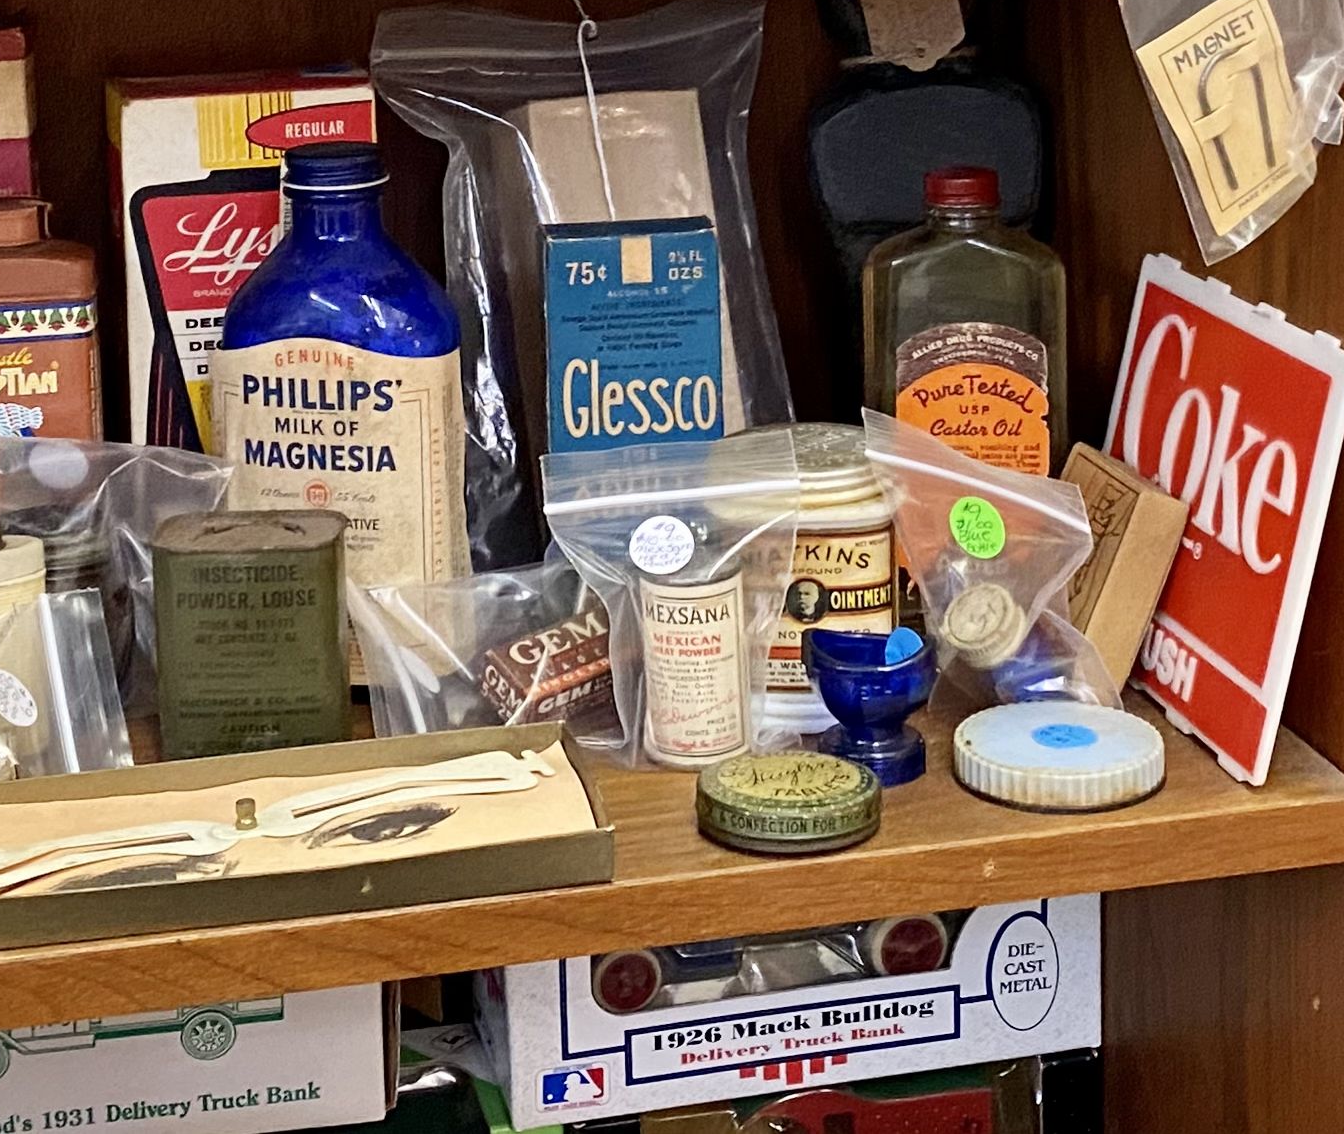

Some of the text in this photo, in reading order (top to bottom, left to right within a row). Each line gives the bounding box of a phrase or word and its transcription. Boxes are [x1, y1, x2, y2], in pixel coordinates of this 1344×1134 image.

[1172, 8, 1259, 76] MAGNET
[284, 119, 345, 139] REGULAR
[565, 261, 608, 286] 75¢
[192, 288, 233, 298] BRAND
[274, 348, 355, 372] GENUINE
[242, 373, 403, 413] PHILLIPS'
[562, 357, 718, 439] Glessco
[912, 374, 1035, 414] Pure Tested
[274, 416, 360, 437] MILK OF
[929, 418, 1024, 437] Castor Oil
[244, 437, 397, 473] MAGNESIA
[1122, 313, 1298, 575] Coke
[261, 588, 318, 609] LOUSE
[829, 584, 892, 610] OINTMENT
[645, 602, 732, 626] MEXSANA
[508, 611, 609, 665] GEM
[653, 633, 722, 648] MEXICAN
[678, 645, 722, 657] POWDER
[485, 664, 524, 710] GEM
[537, 681, 594, 714] GEM
[730, 813, 808, 835] CONFECTION
[1006, 941, 1046, 959] DIE-
[1004, 957, 1047, 976] CAST
[999, 976, 1053, 996] METAL
[650, 997, 936, 1052] 1926 Mack Bulldog
[680, 1022, 906, 1067] Delivery Truck Bank
[42, 1105, 97, 1130] 1931
[105, 1097, 193, 1128] Delivery
[197, 1088, 262, 1115] Truck
[265, 1080, 322, 1105] Bank
